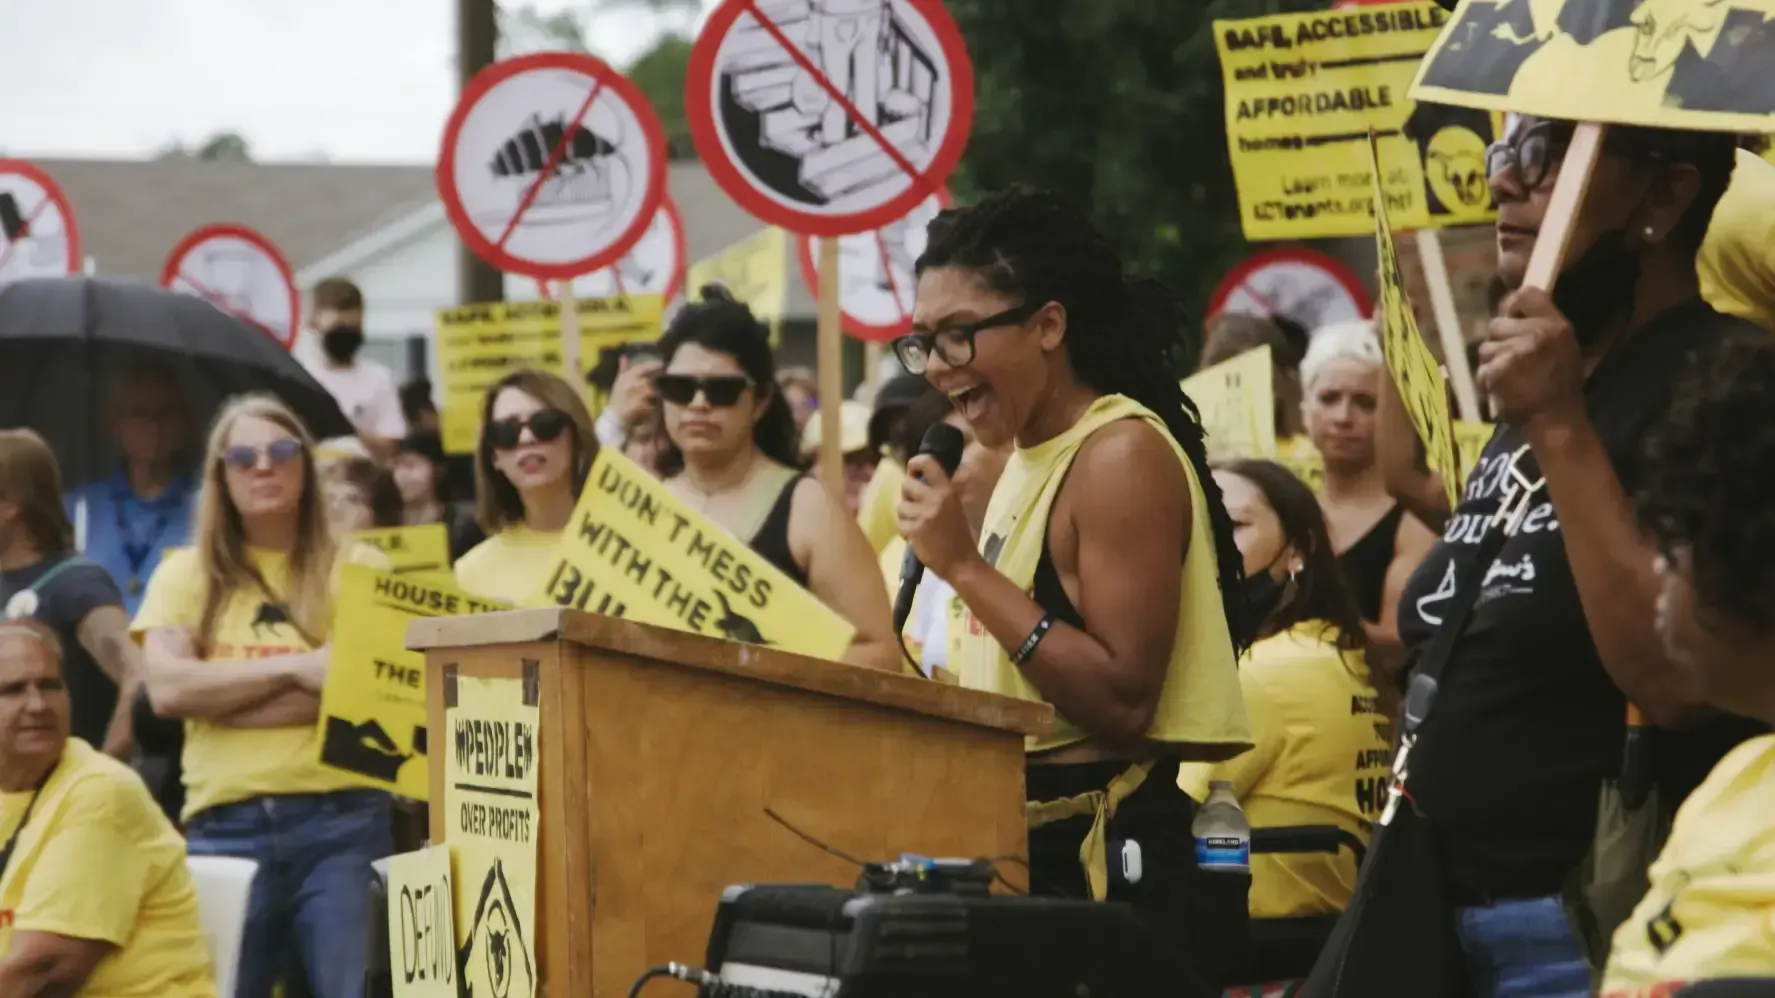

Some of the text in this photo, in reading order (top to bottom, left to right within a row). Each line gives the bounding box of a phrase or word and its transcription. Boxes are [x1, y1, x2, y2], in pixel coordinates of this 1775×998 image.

[1297, 7, 1445, 45] ACCESSIBLE
[1236, 86, 1392, 122] AFFORDABLE
[597, 462, 773, 609] DON'T MESS
[578, 511, 713, 631] WITH THE
[374, 575, 459, 614] HOUSE
[374, 657, 422, 690] THE
[466, 718, 524, 779] PEOPLE
[460, 802, 486, 837] OVER
[400, 873, 453, 985] DEFUND
